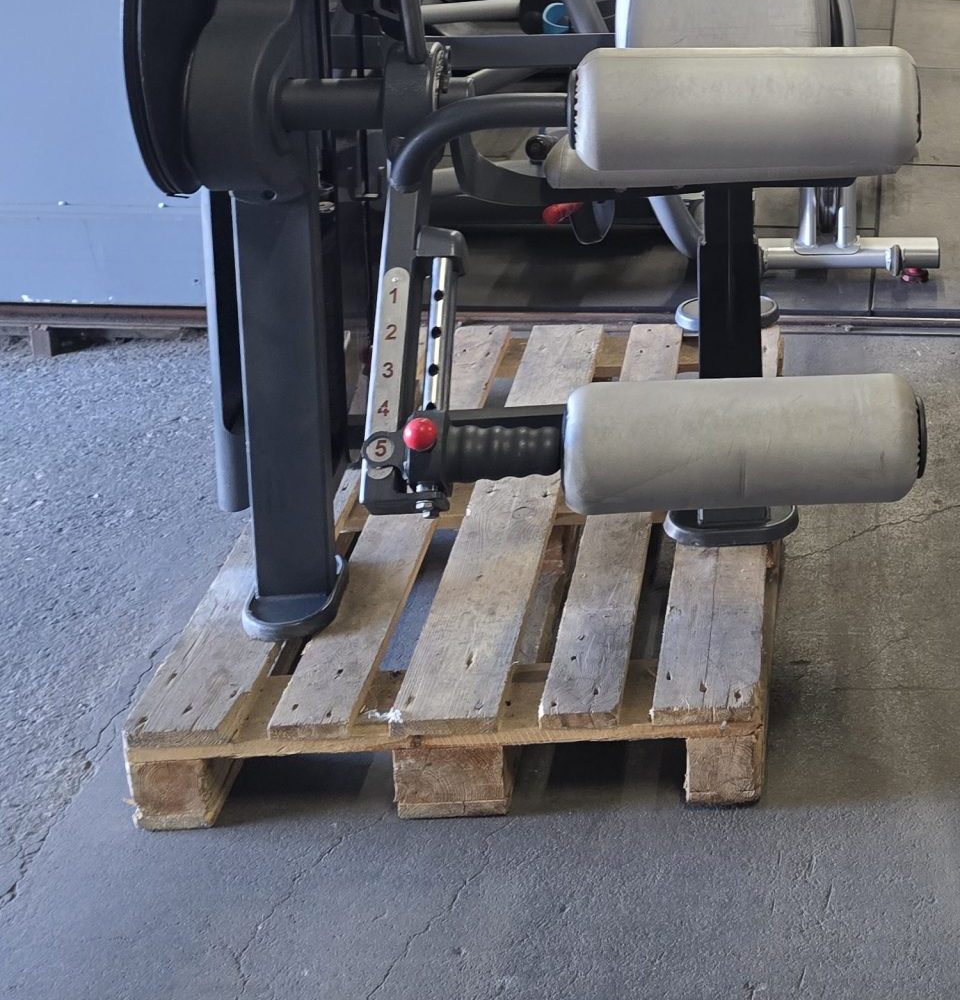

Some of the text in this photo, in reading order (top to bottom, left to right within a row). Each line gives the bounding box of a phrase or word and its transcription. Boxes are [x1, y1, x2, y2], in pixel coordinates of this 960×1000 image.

[389, 288, 398, 304] 1
[385, 324, 397, 340] 2
[382, 362, 394, 378] 3
[377, 400, 390, 416] 4
[374, 440, 387, 457] 5
